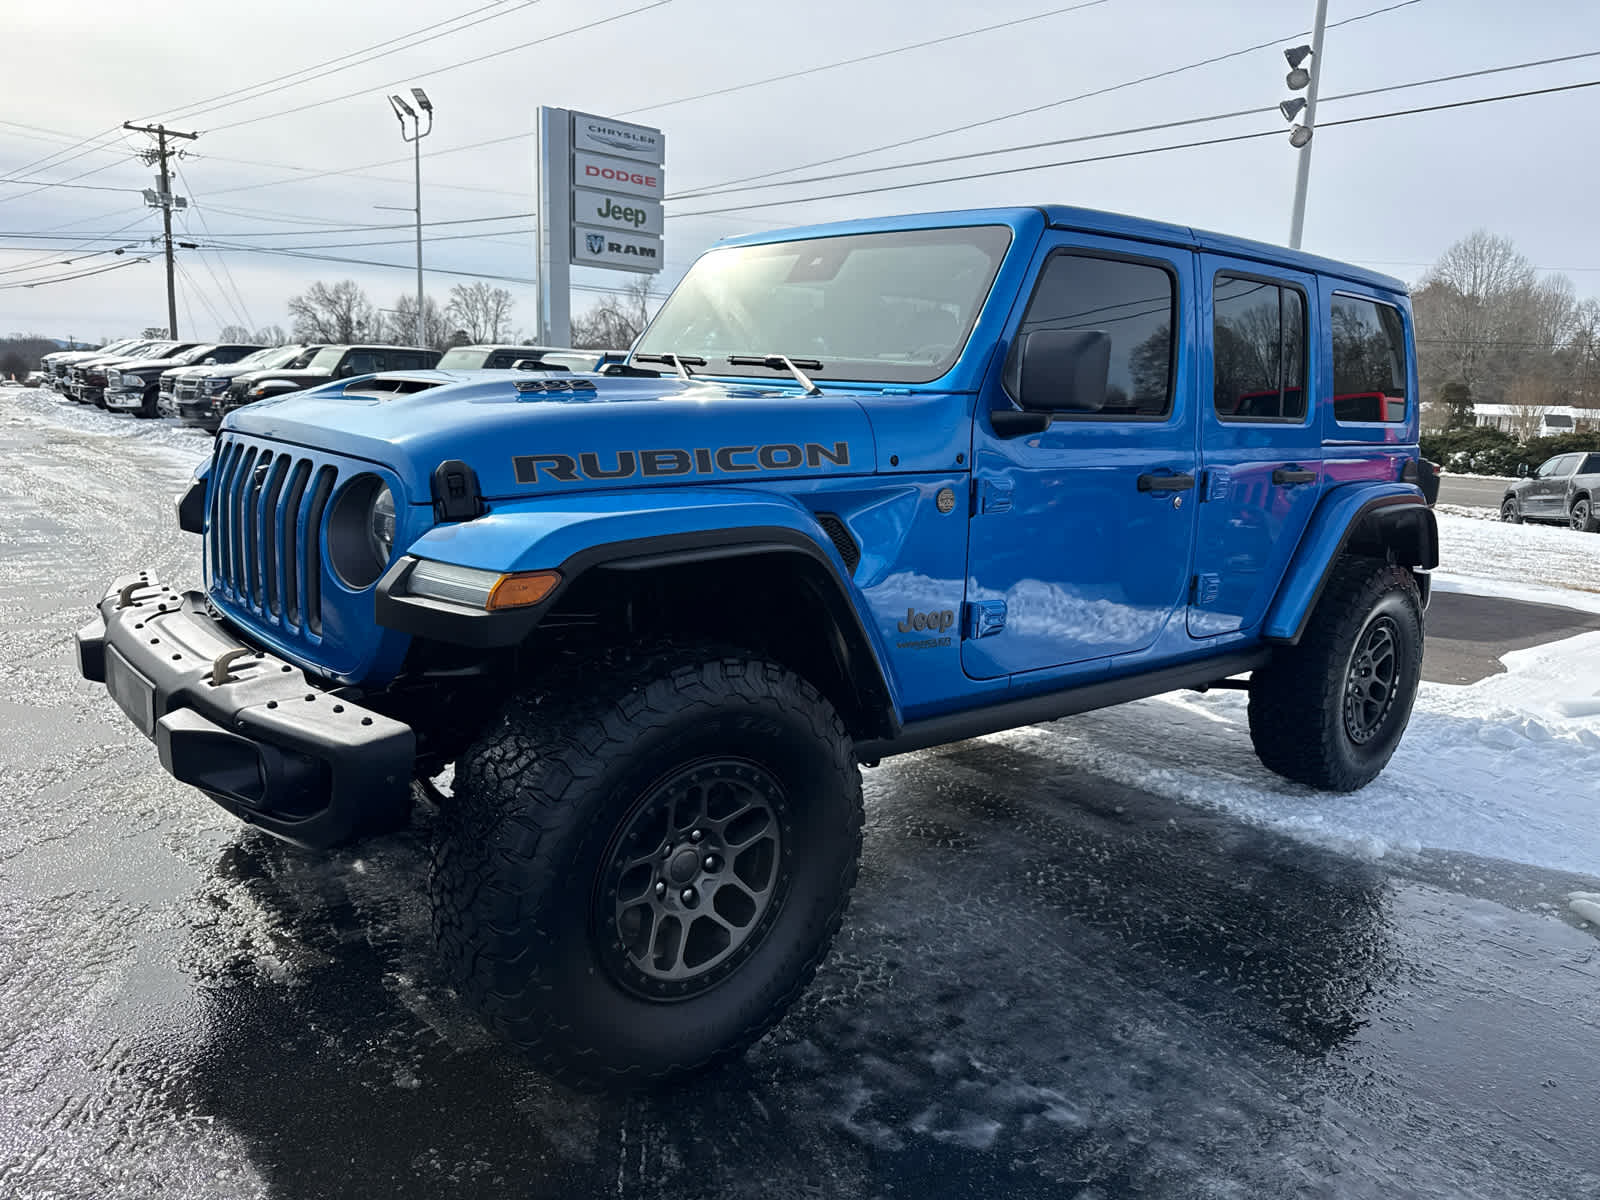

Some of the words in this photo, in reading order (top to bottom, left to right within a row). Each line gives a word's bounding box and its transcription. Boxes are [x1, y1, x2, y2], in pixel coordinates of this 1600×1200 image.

[588, 125, 656, 144] CHRYSLER
[585, 165, 657, 187] DODGE
[597, 198, 647, 228] Jeep
[607, 242, 657, 258] RAM
[512, 441, 849, 484] RUBICON
[897, 607, 955, 633] Jeep
